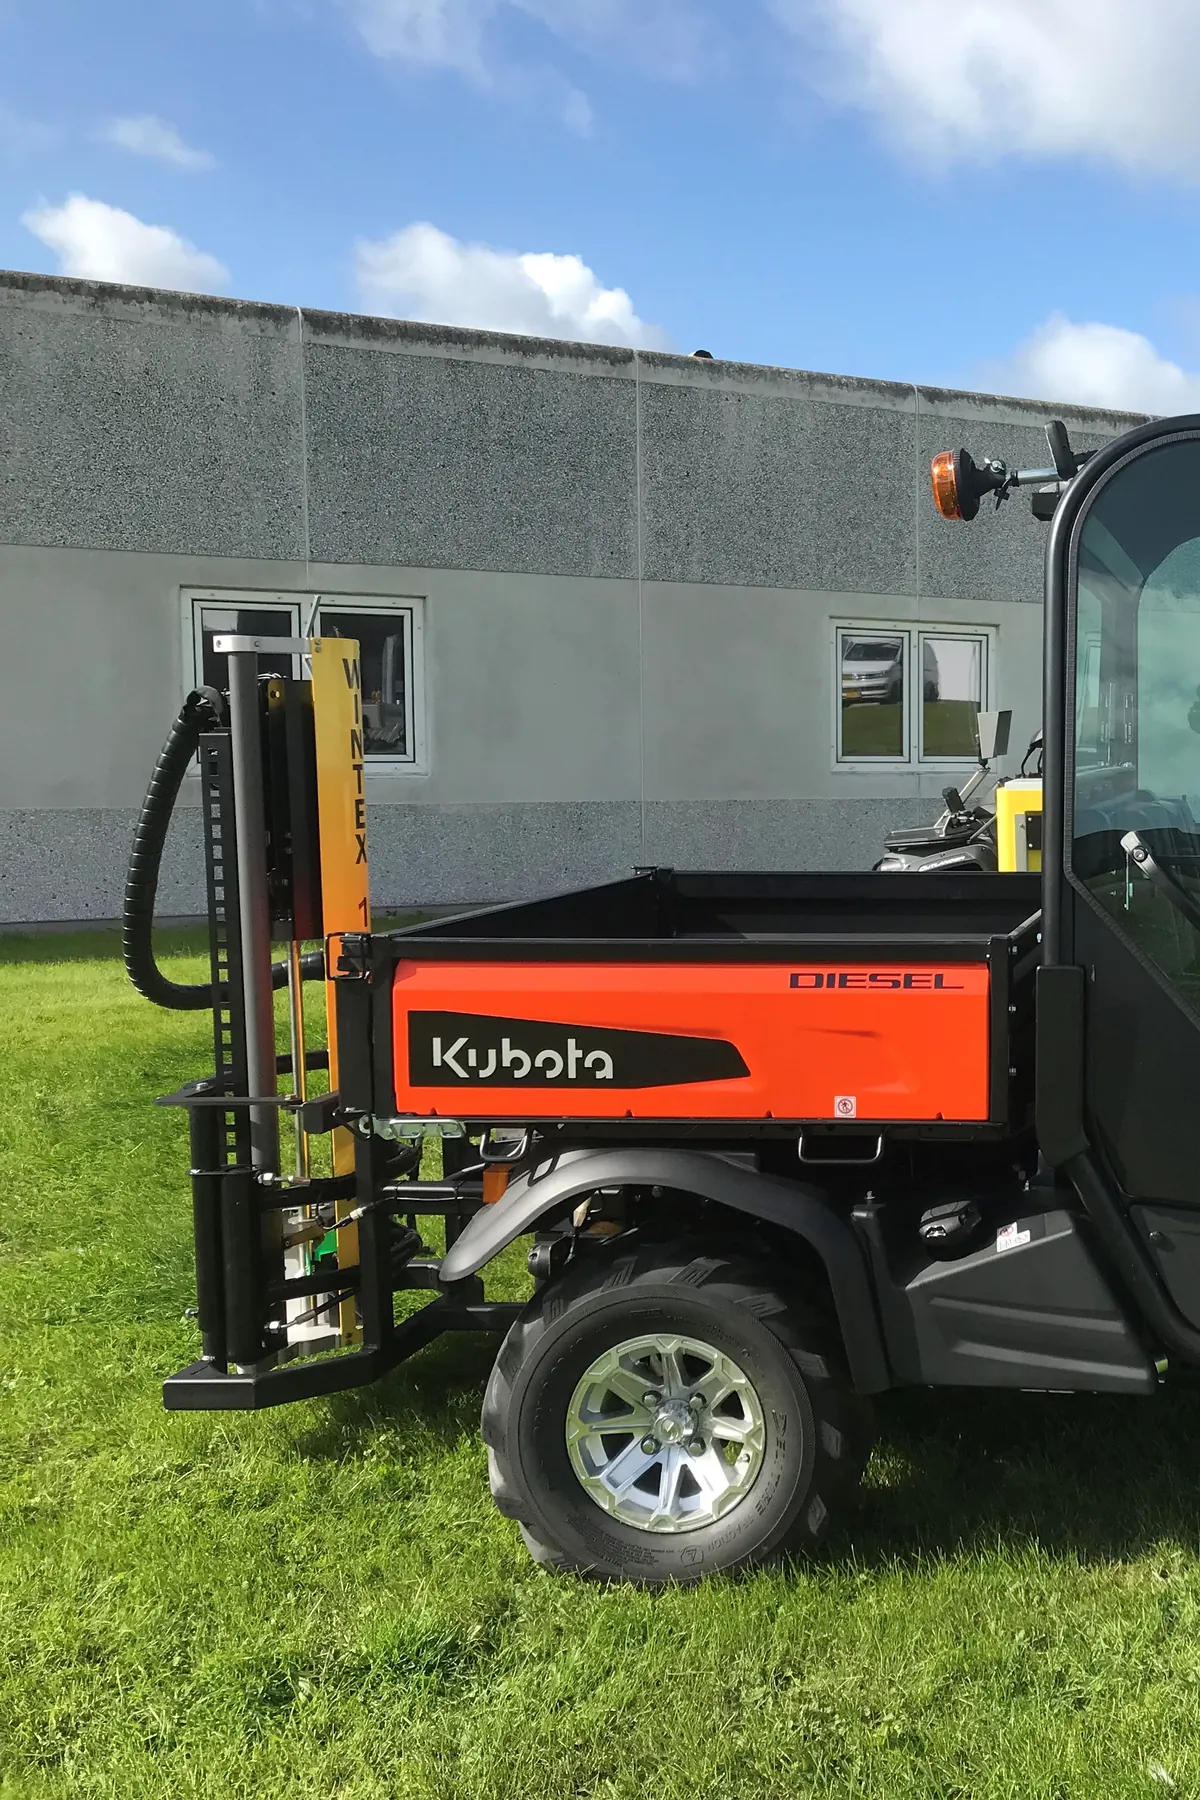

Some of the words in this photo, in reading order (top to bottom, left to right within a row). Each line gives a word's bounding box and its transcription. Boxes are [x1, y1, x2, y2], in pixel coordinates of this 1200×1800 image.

[342, 657, 368, 865] WINTEX
[789, 973, 965, 989] DIESEL
[432, 1037, 614, 1080] Kubota
